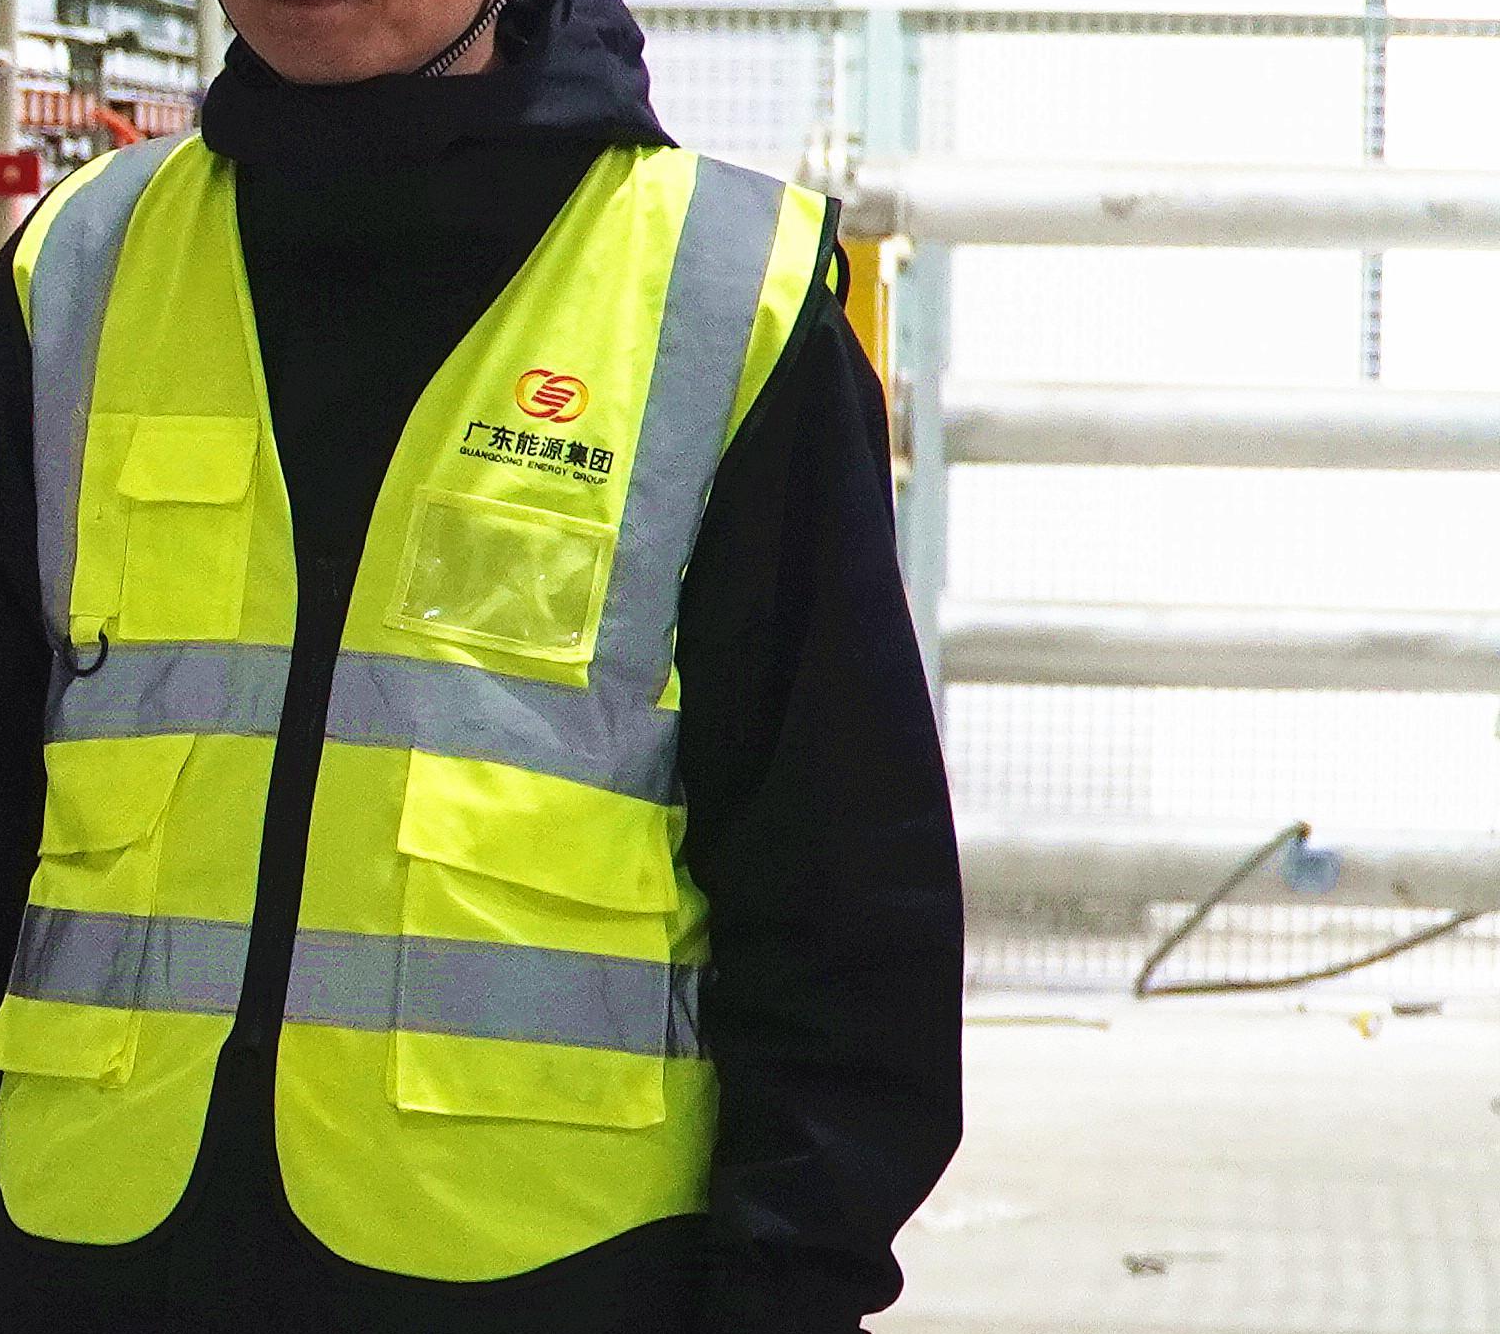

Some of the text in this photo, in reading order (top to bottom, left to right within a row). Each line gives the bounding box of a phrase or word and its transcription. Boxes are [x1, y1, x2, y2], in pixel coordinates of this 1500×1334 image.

[459, 445, 607, 485] GUANGDONG ENERGY GROUP
[463, 420, 614, 474] 广东能源集团
